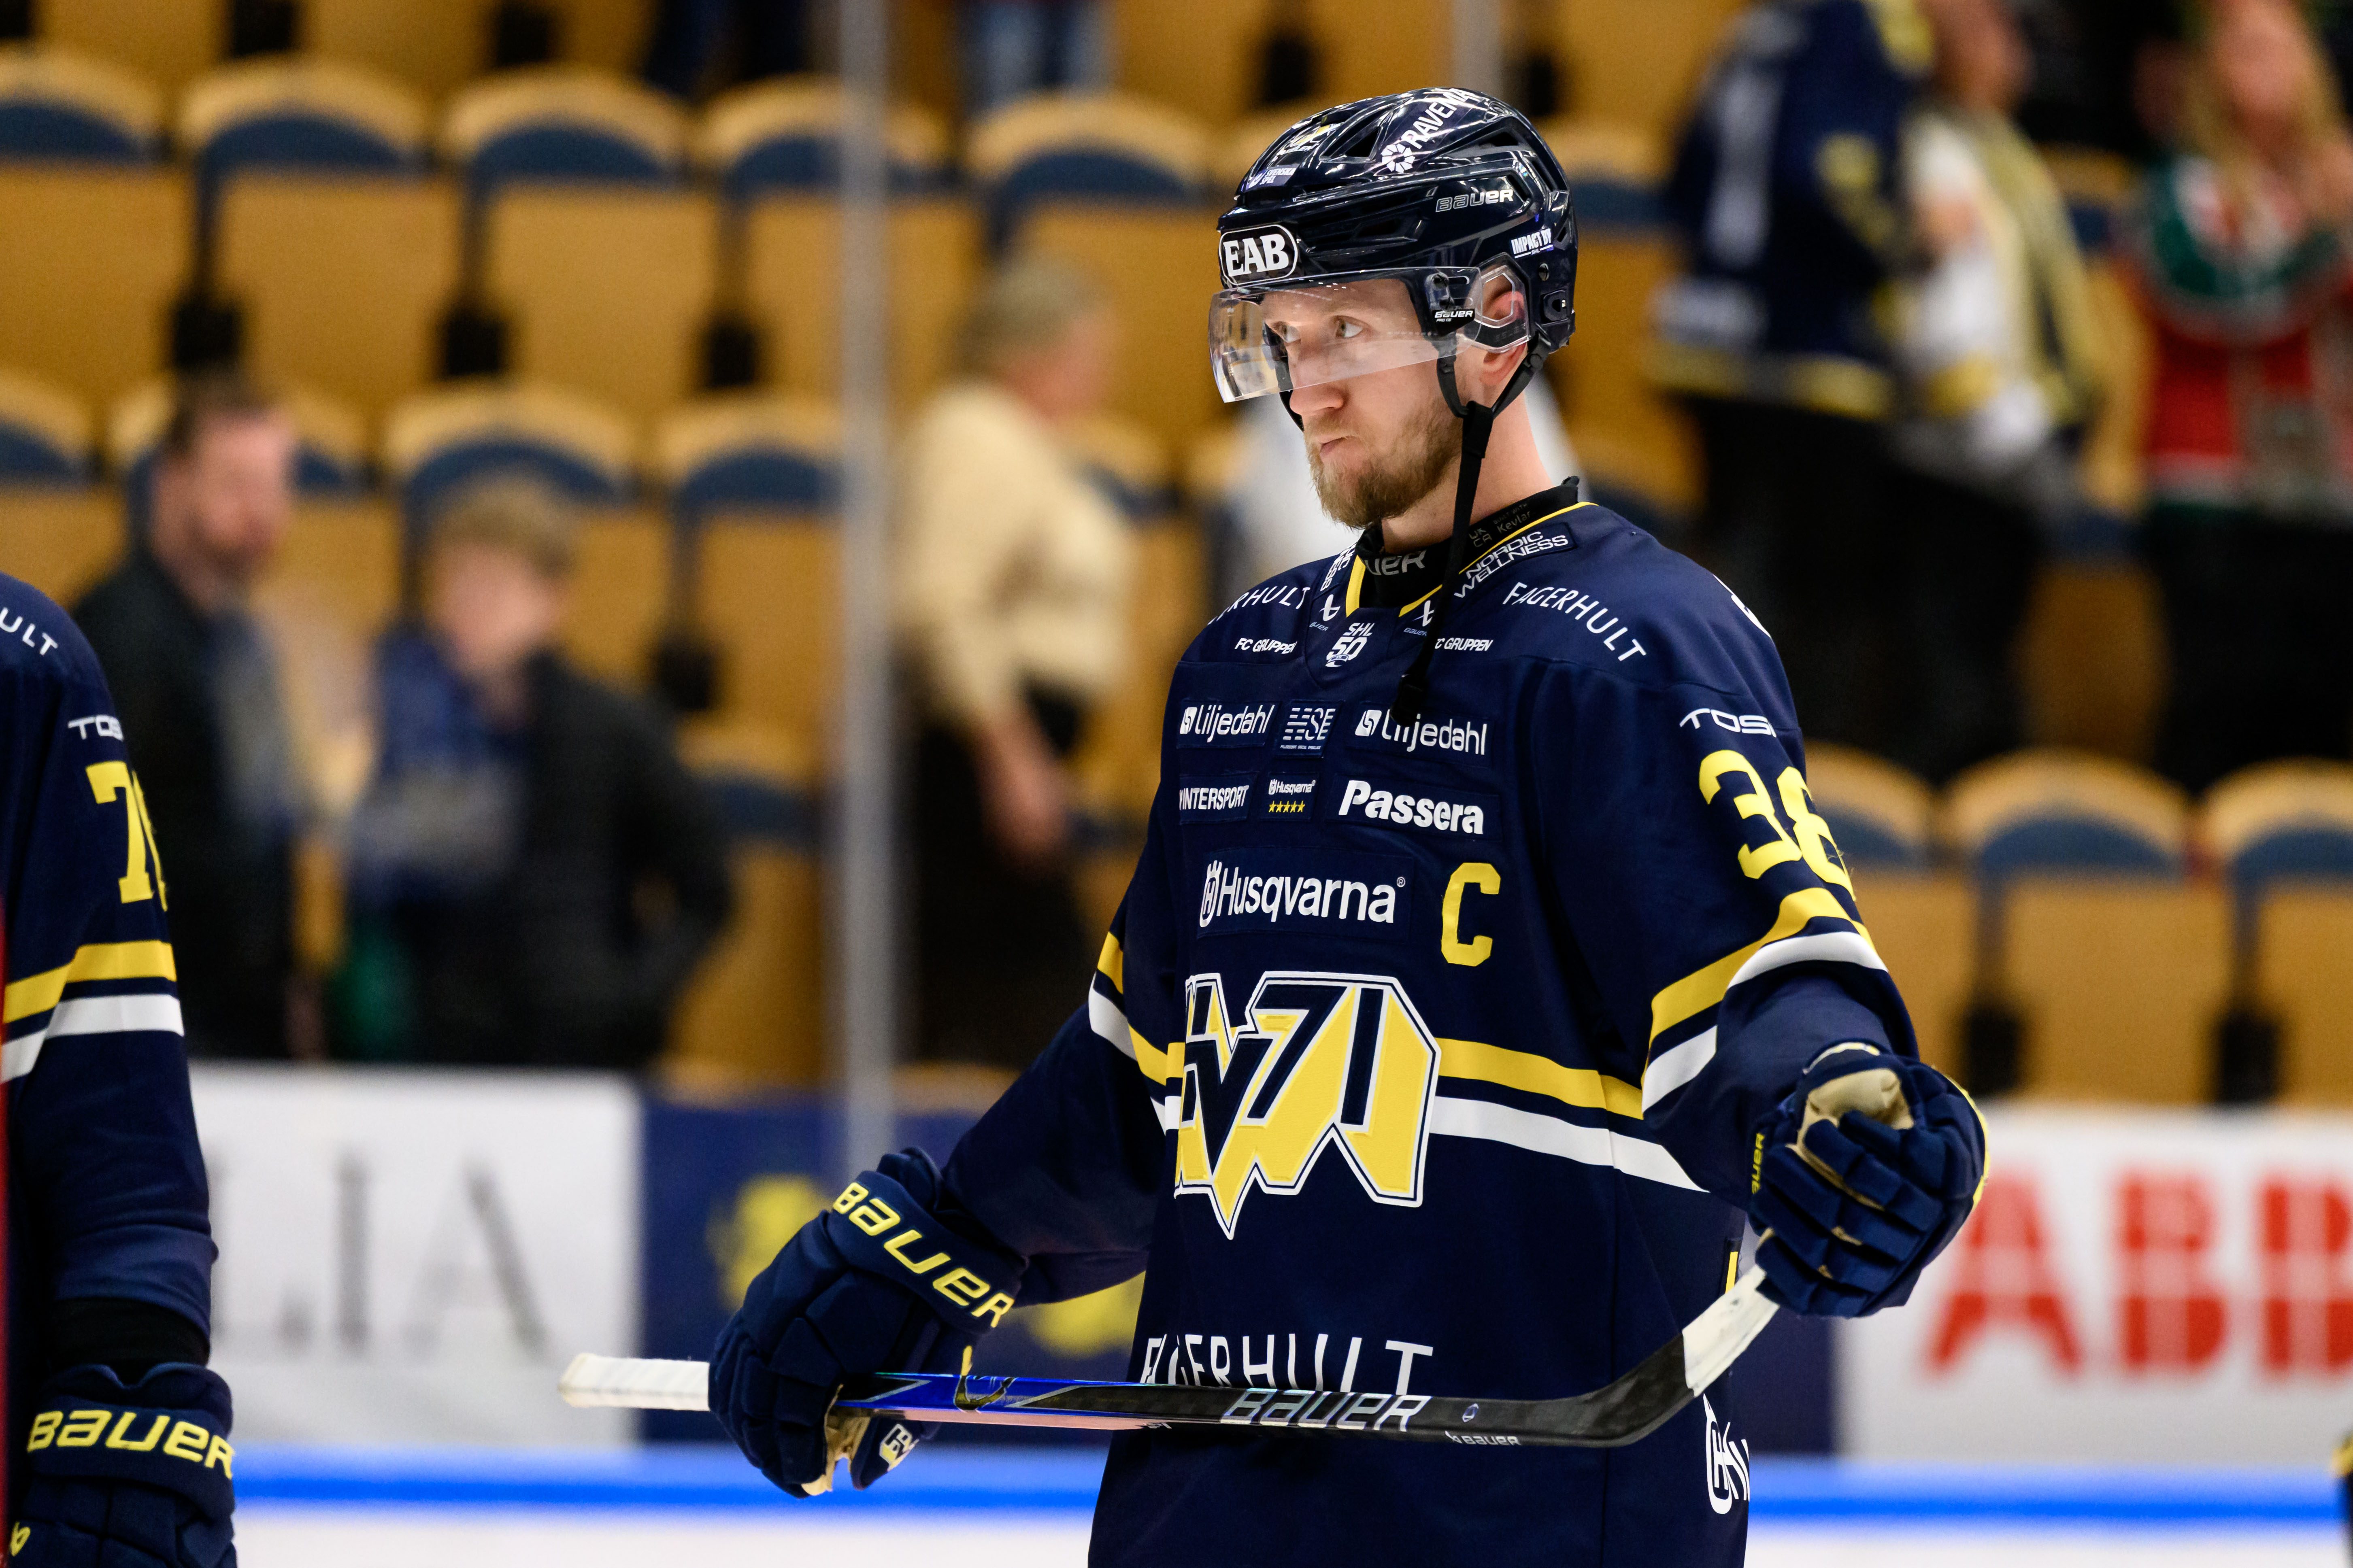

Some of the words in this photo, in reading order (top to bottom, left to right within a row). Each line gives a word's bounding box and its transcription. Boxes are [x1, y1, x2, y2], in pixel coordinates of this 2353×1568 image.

[1259, 175, 1276, 185] SPEL
[1265, 167, 1296, 177] SVENSKA
[1511, 231, 1542, 255] IMPACT
[1541, 228, 1552, 246] BY
[1223, 234, 1289, 277] EAB
[1496, 510, 1532, 534] Kevlar
[1363, 550, 1427, 576] UER
[1454, 535, 1568, 598] WELLNESS
[1466, 531, 1543, 580] NORDIC
[0, 607, 58, 656] ULT
[1342, 623, 1375, 637] SHL
[1502, 582, 1647, 661] FAGERHULT
[1234, 638, 1253, 650] FC
[1253, 639, 1298, 654] GRUPPEN
[1326, 637, 1368, 661] 50
[1434, 638, 1445, 649] C
[1444, 637, 1494, 651] GRUPPEN
[1182, 785, 1249, 810] INTERSPORT
[1338, 780, 1484, 834] Passera
[85, 760, 168, 911] 7
[1440, 862, 1501, 967] C
[1751, 1132, 1766, 1195] AUER
